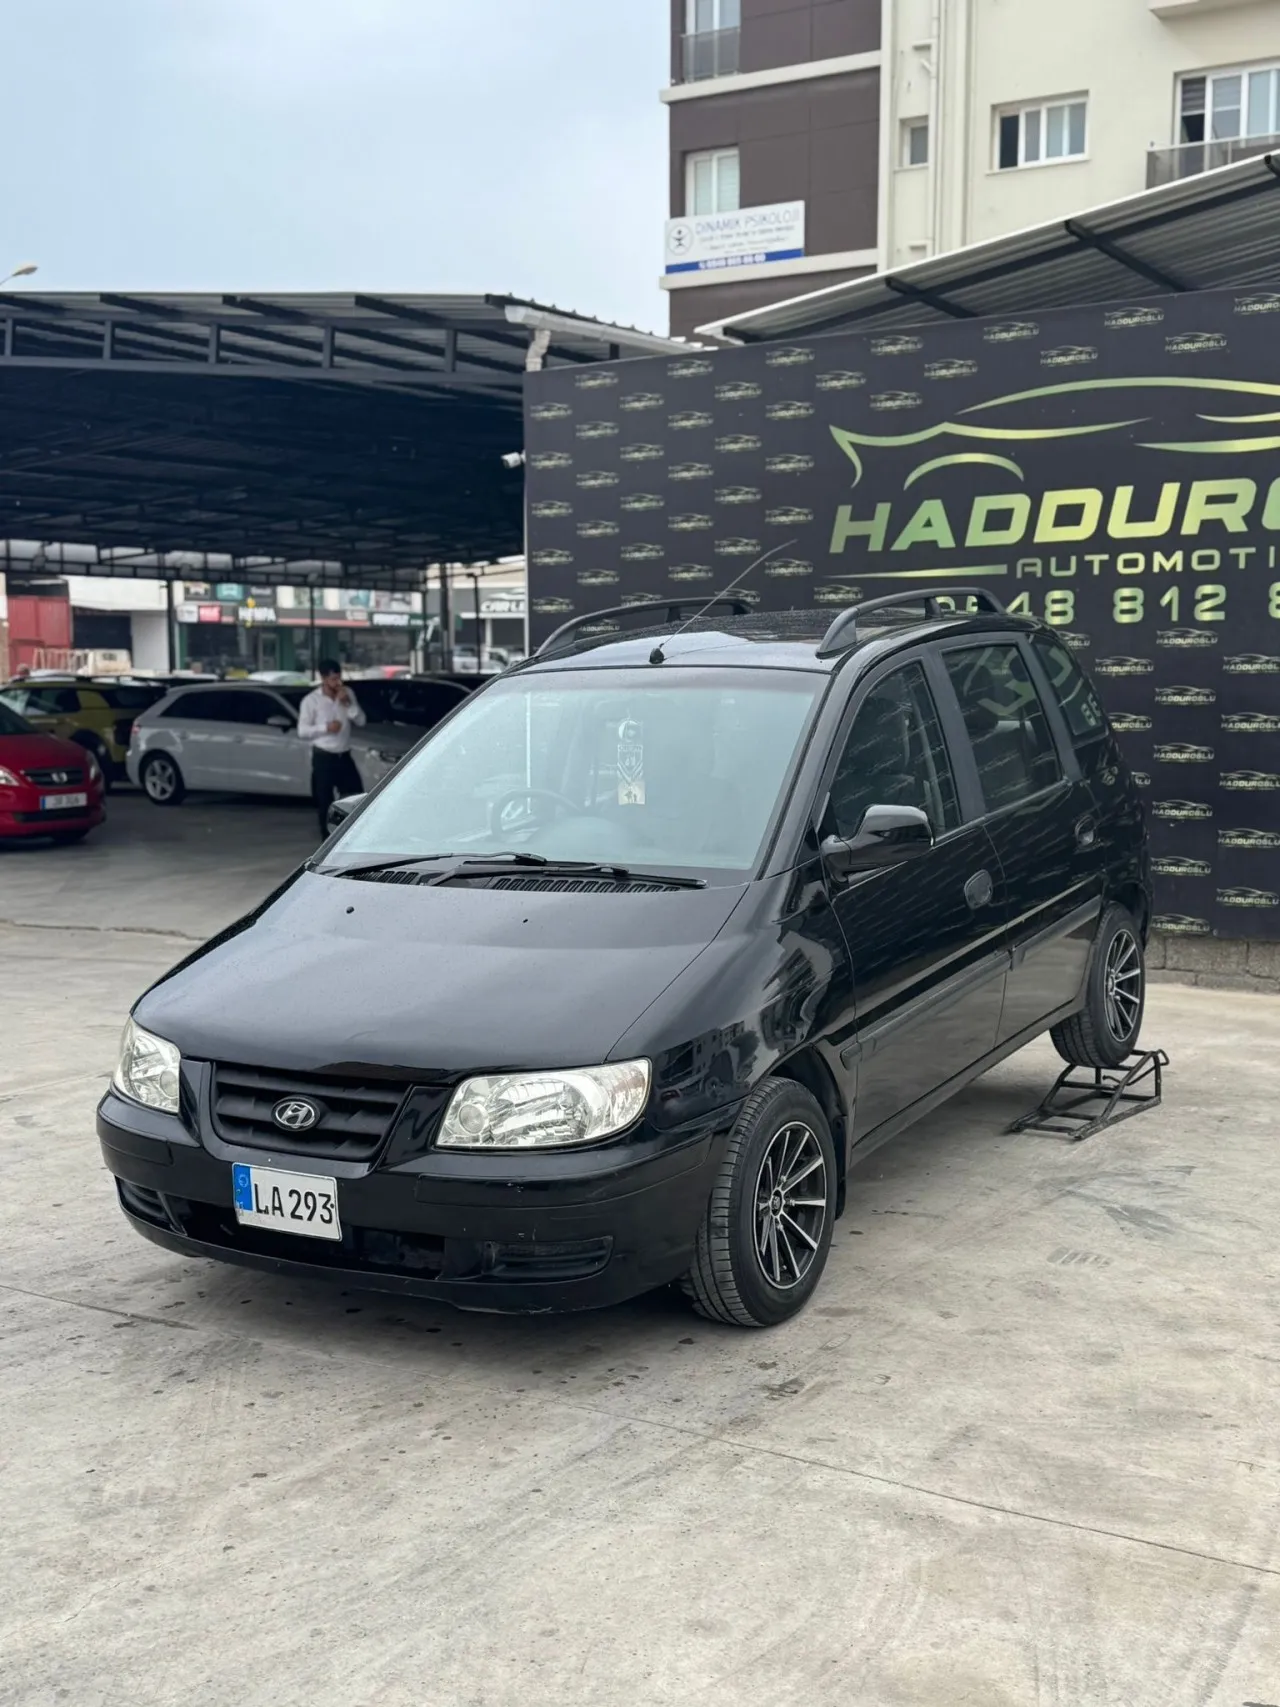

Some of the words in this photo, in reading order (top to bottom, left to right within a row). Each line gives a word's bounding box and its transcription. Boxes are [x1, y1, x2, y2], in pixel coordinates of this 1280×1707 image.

[829, 477, 1280, 553] HADDUR
[1017, 545, 1275, 579] AUTOMOTI
[1113, 584, 1227, 624] 812
[254, 1183, 285, 1218] LA
[288, 1189, 333, 1225] 293
